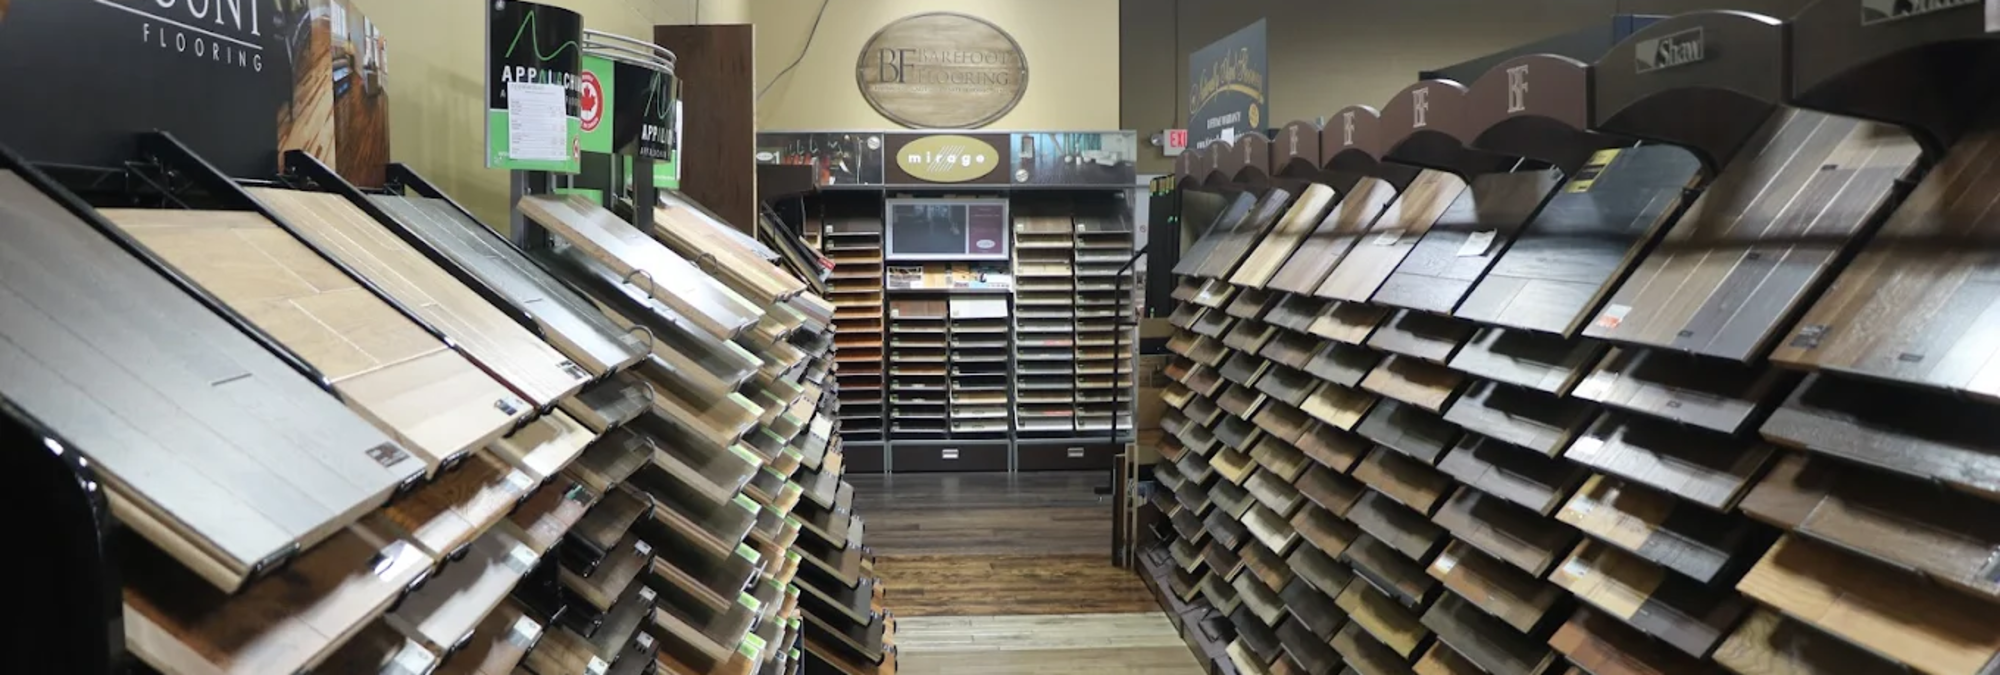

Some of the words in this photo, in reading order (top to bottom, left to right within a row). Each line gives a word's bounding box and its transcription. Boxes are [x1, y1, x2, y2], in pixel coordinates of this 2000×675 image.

[143, 23, 262, 72] FLOORING
[918, 47, 1010, 65] BAREFOOT
[1659, 37, 1702, 68] Shaw
[879, 47, 917, 84] BF
[918, 69, 1010, 86] FLOORING
[1507, 64, 1529, 113] BF
[1412, 86, 1430, 128] BF
[1170, 130, 1188, 148] EXI
[908, 150, 985, 168] mirage
